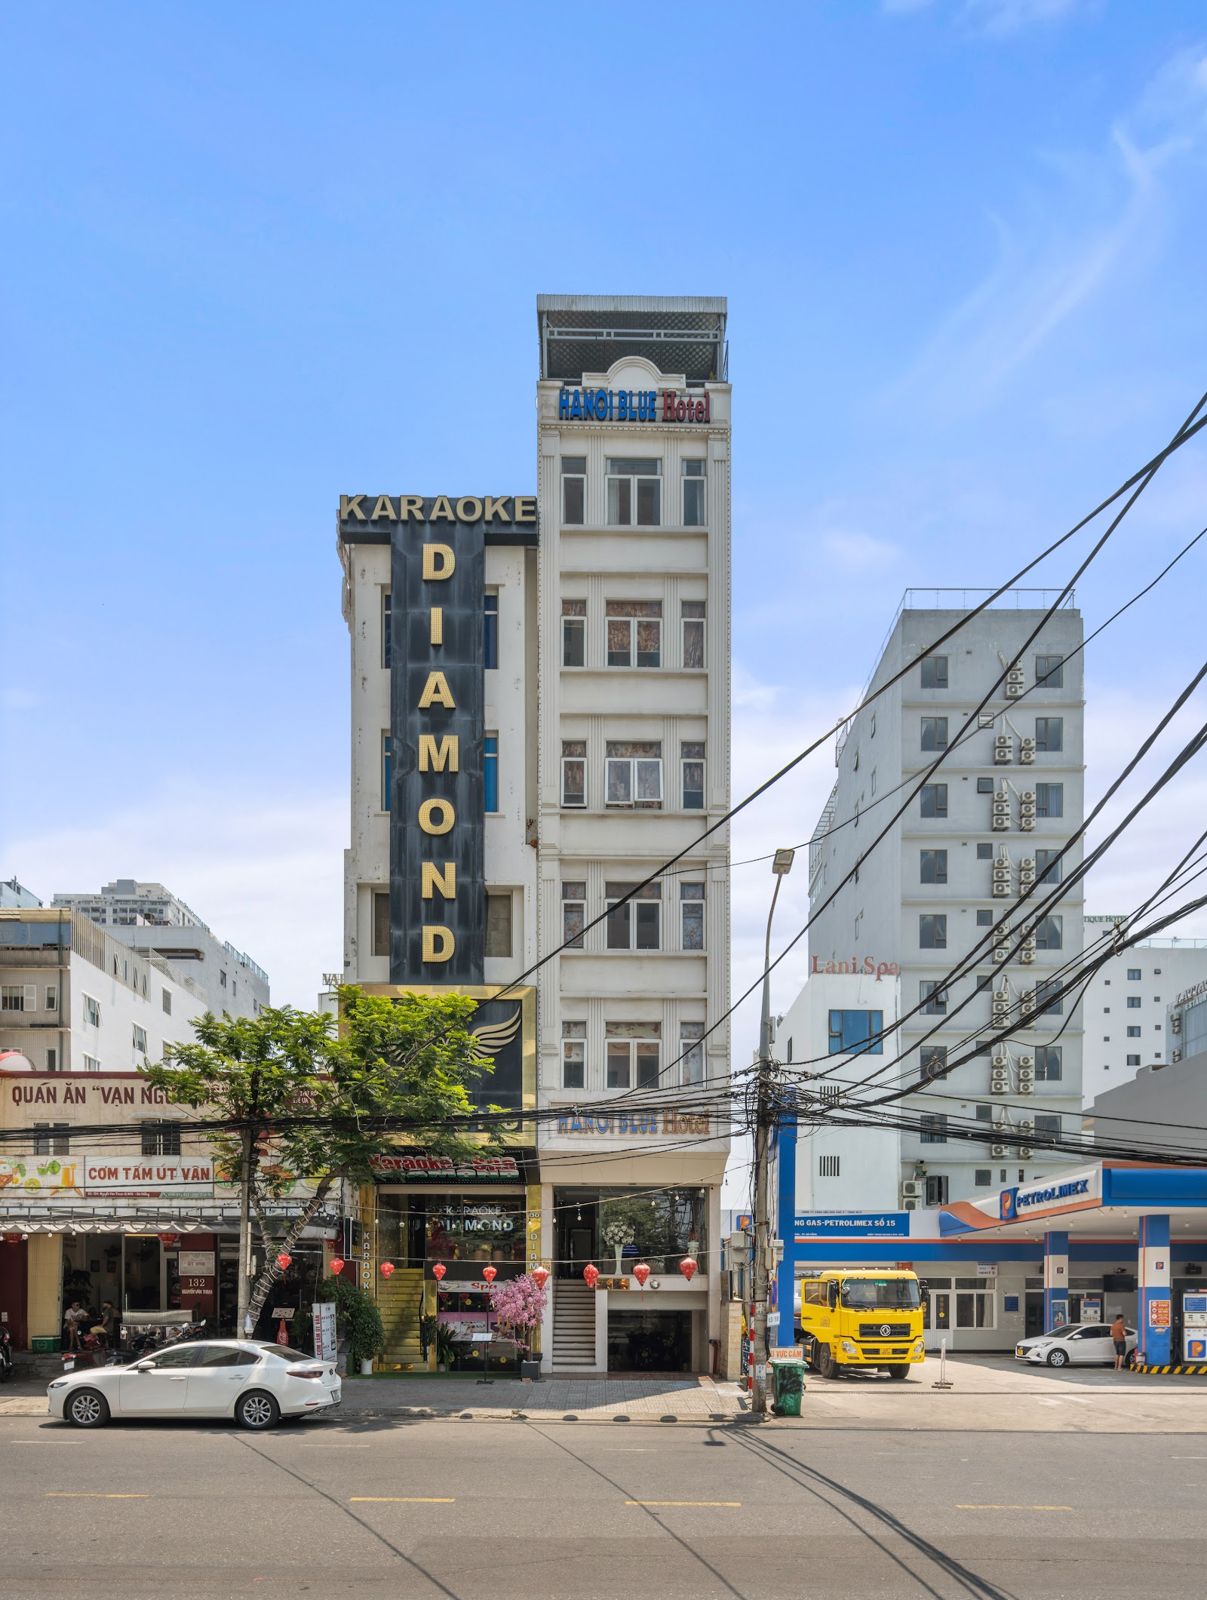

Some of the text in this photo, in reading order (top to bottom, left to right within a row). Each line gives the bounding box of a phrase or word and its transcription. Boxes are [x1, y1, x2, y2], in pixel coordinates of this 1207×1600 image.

[559, 389, 710, 423] HANOI BLUE Hotel
[339, 494, 537, 522] KARAOKE
[417, 543, 459, 963] DIAMOND
[811, 955, 900, 982] Lani Spa
[12, 1082, 57, 1106] QUÁN
[63, 1082, 86, 1104] ĂN
[557, 1108, 711, 1135] HANOI BLUE Hotel
[88, 1162, 210, 1181] CƠM TẤM ÚT VÂN
[1017, 1179, 1088, 1208] PETROLIMEX
[806, 1219, 873, 1227] GAS-PETROLIMEX
[886, 1219, 896, 1227] 15
[362, 1232, 370, 1296] KARAOK
[188, 1278, 206, 1287] 132
